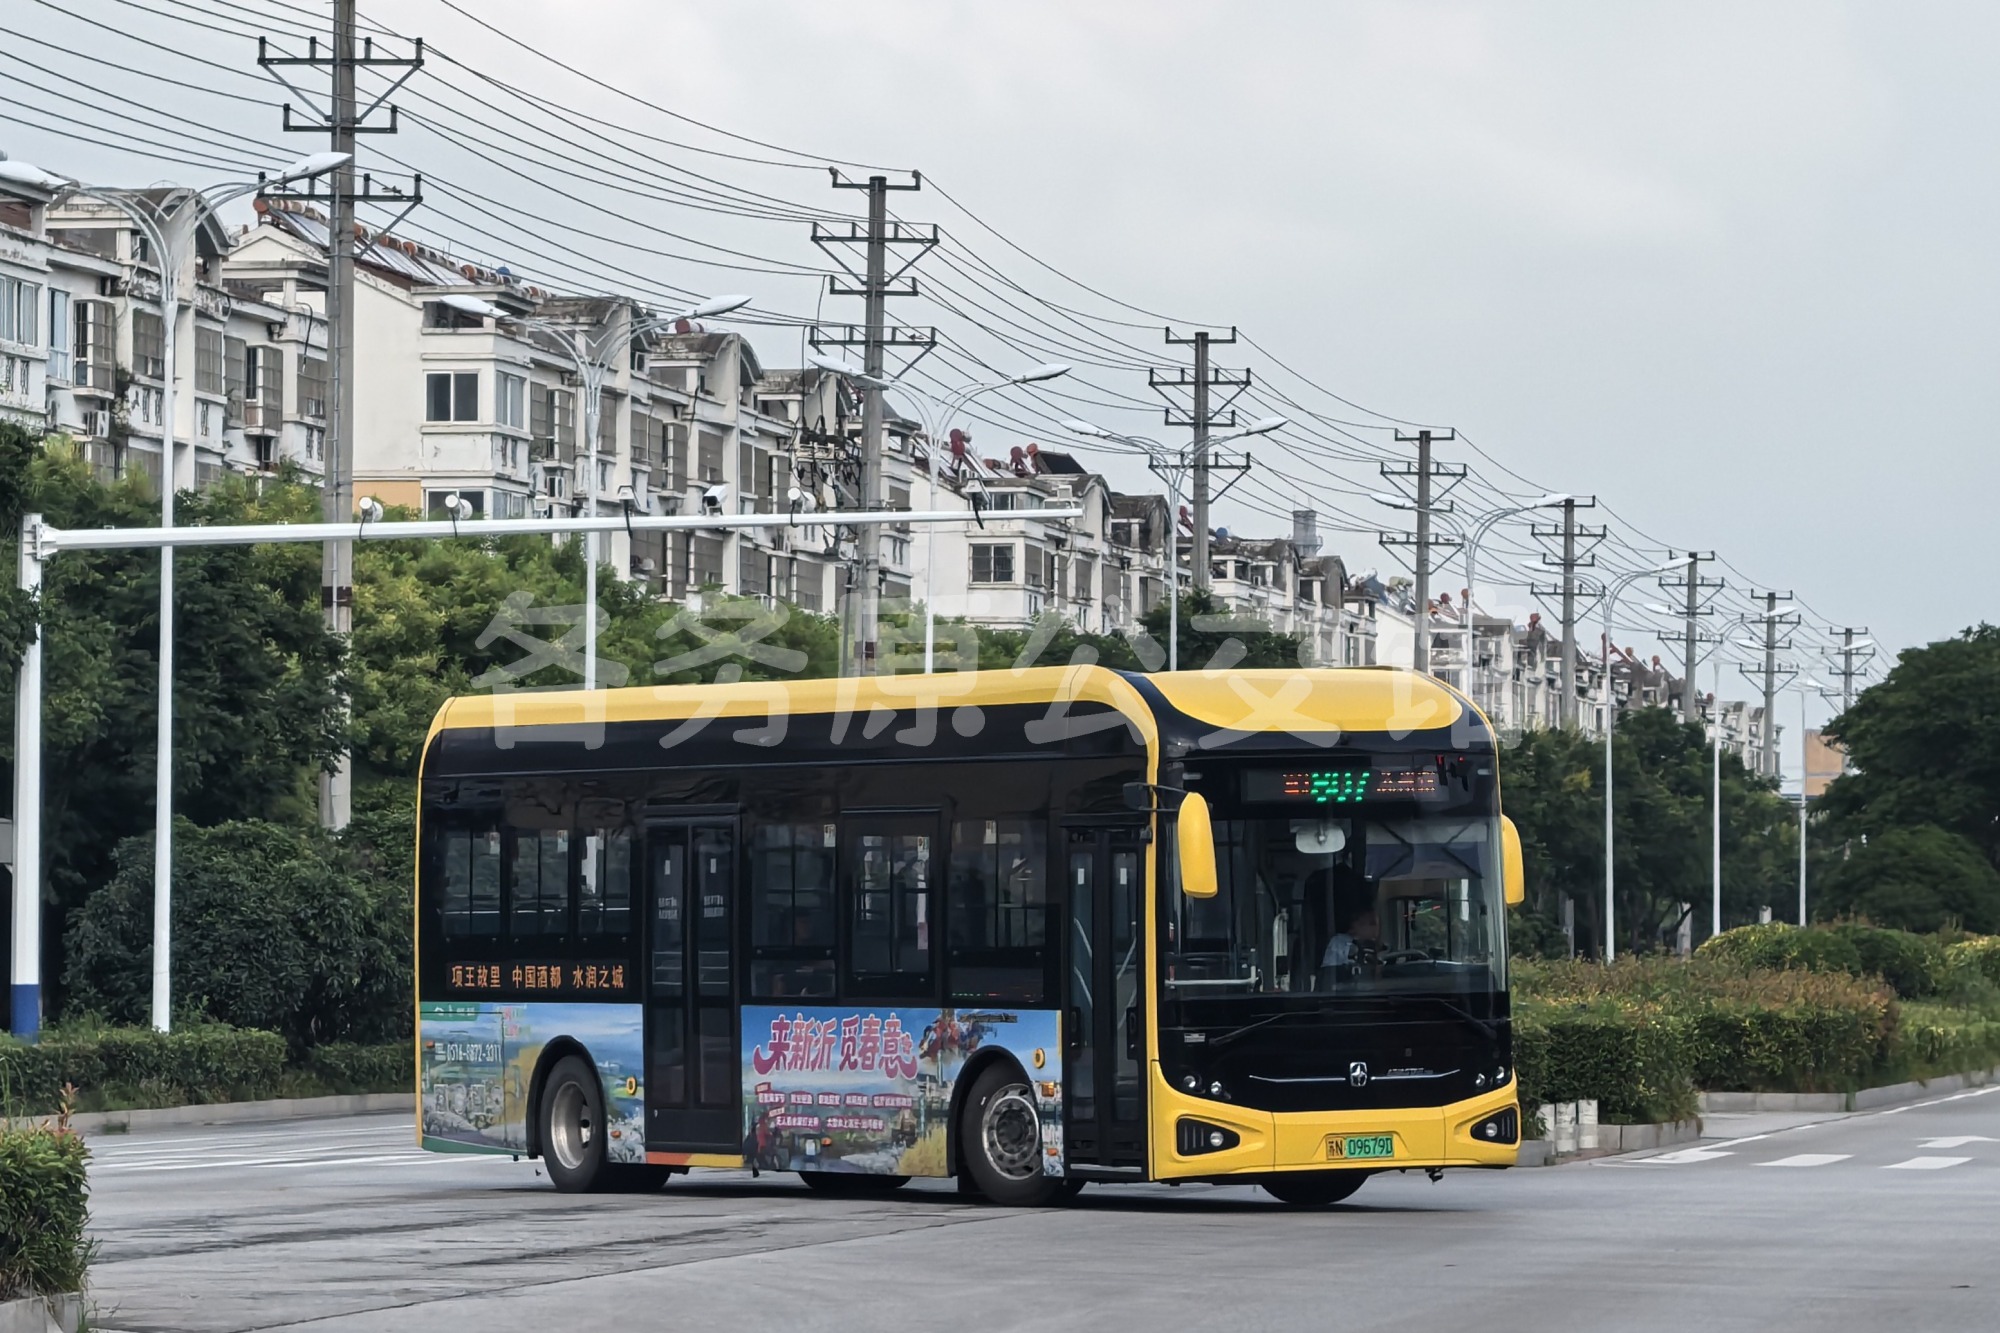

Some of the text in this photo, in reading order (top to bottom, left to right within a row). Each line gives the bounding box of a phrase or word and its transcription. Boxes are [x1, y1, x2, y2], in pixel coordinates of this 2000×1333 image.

[452, 965, 624, 989] 项王故里 中国酒都 水润之城
